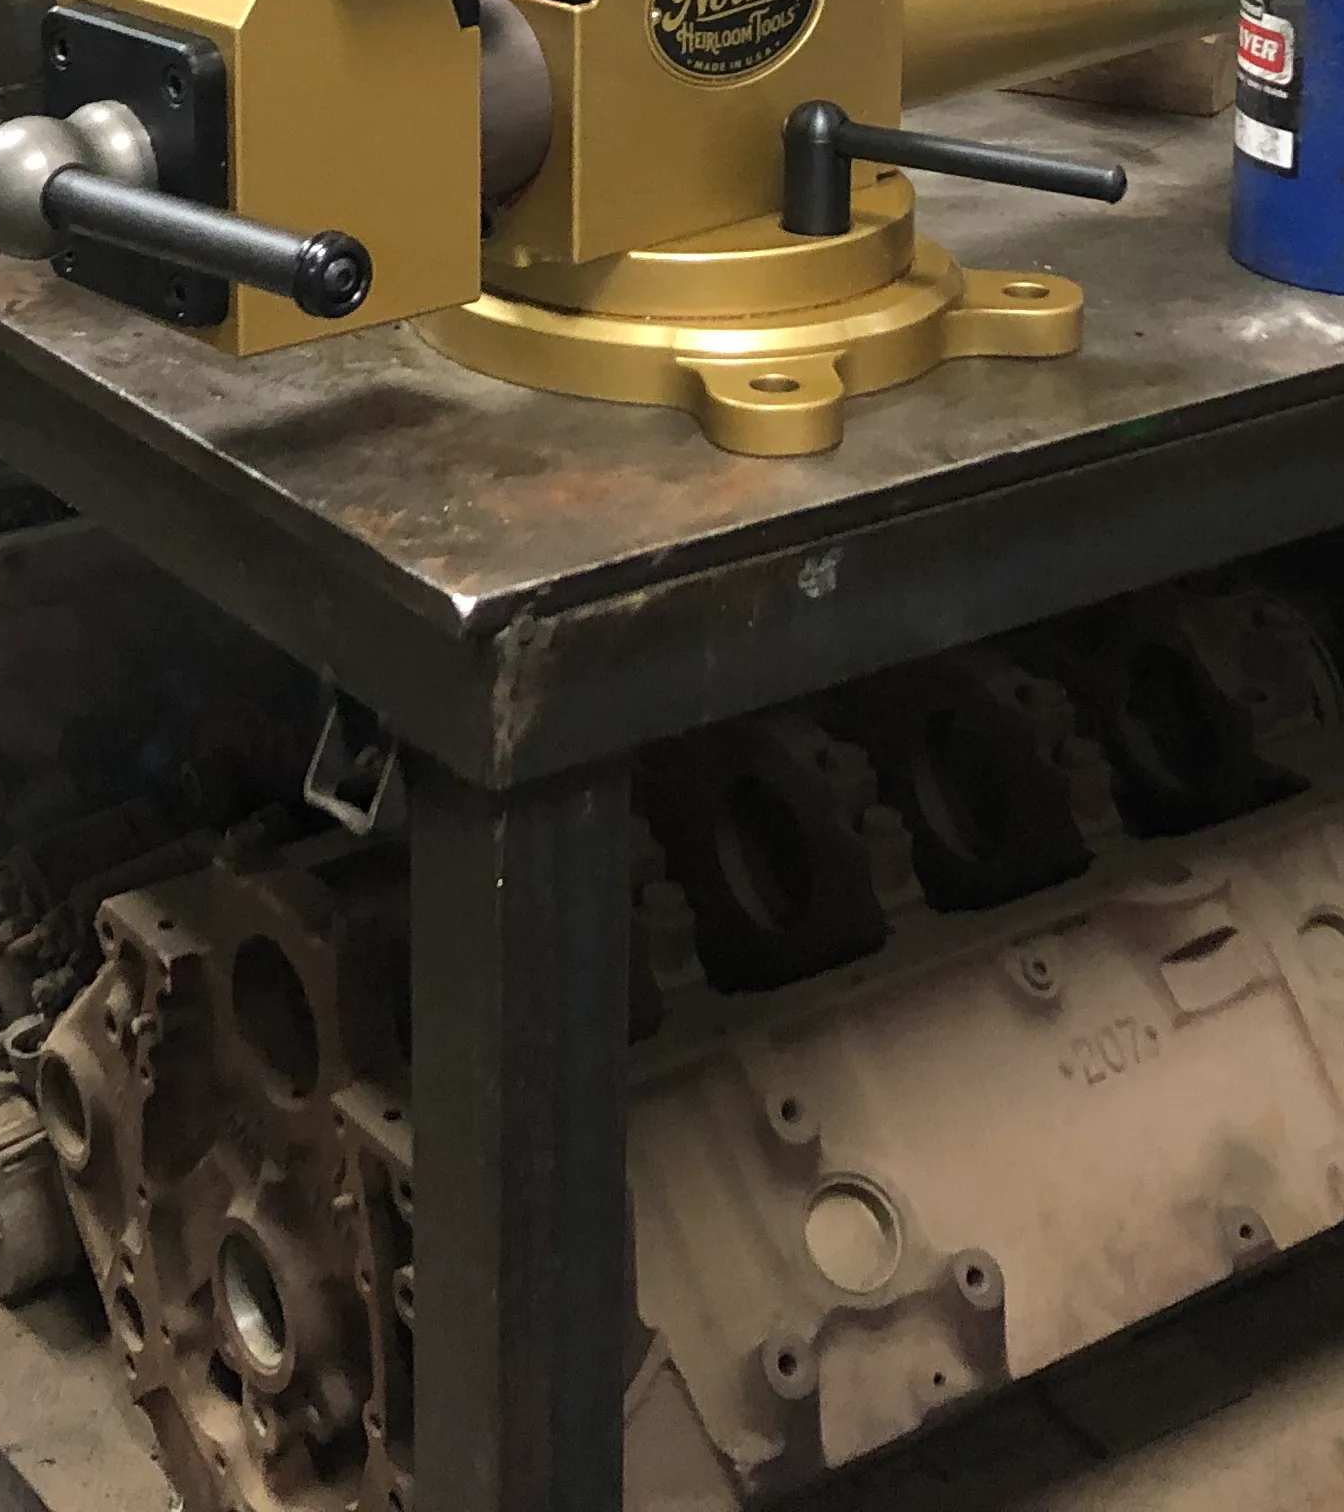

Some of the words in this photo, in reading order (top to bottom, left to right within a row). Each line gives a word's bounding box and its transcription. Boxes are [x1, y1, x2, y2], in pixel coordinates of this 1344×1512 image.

[1239, 25, 1279, 63] YER
[693, 59, 726, 72] MADE
[729, 58, 743, 71] IN
